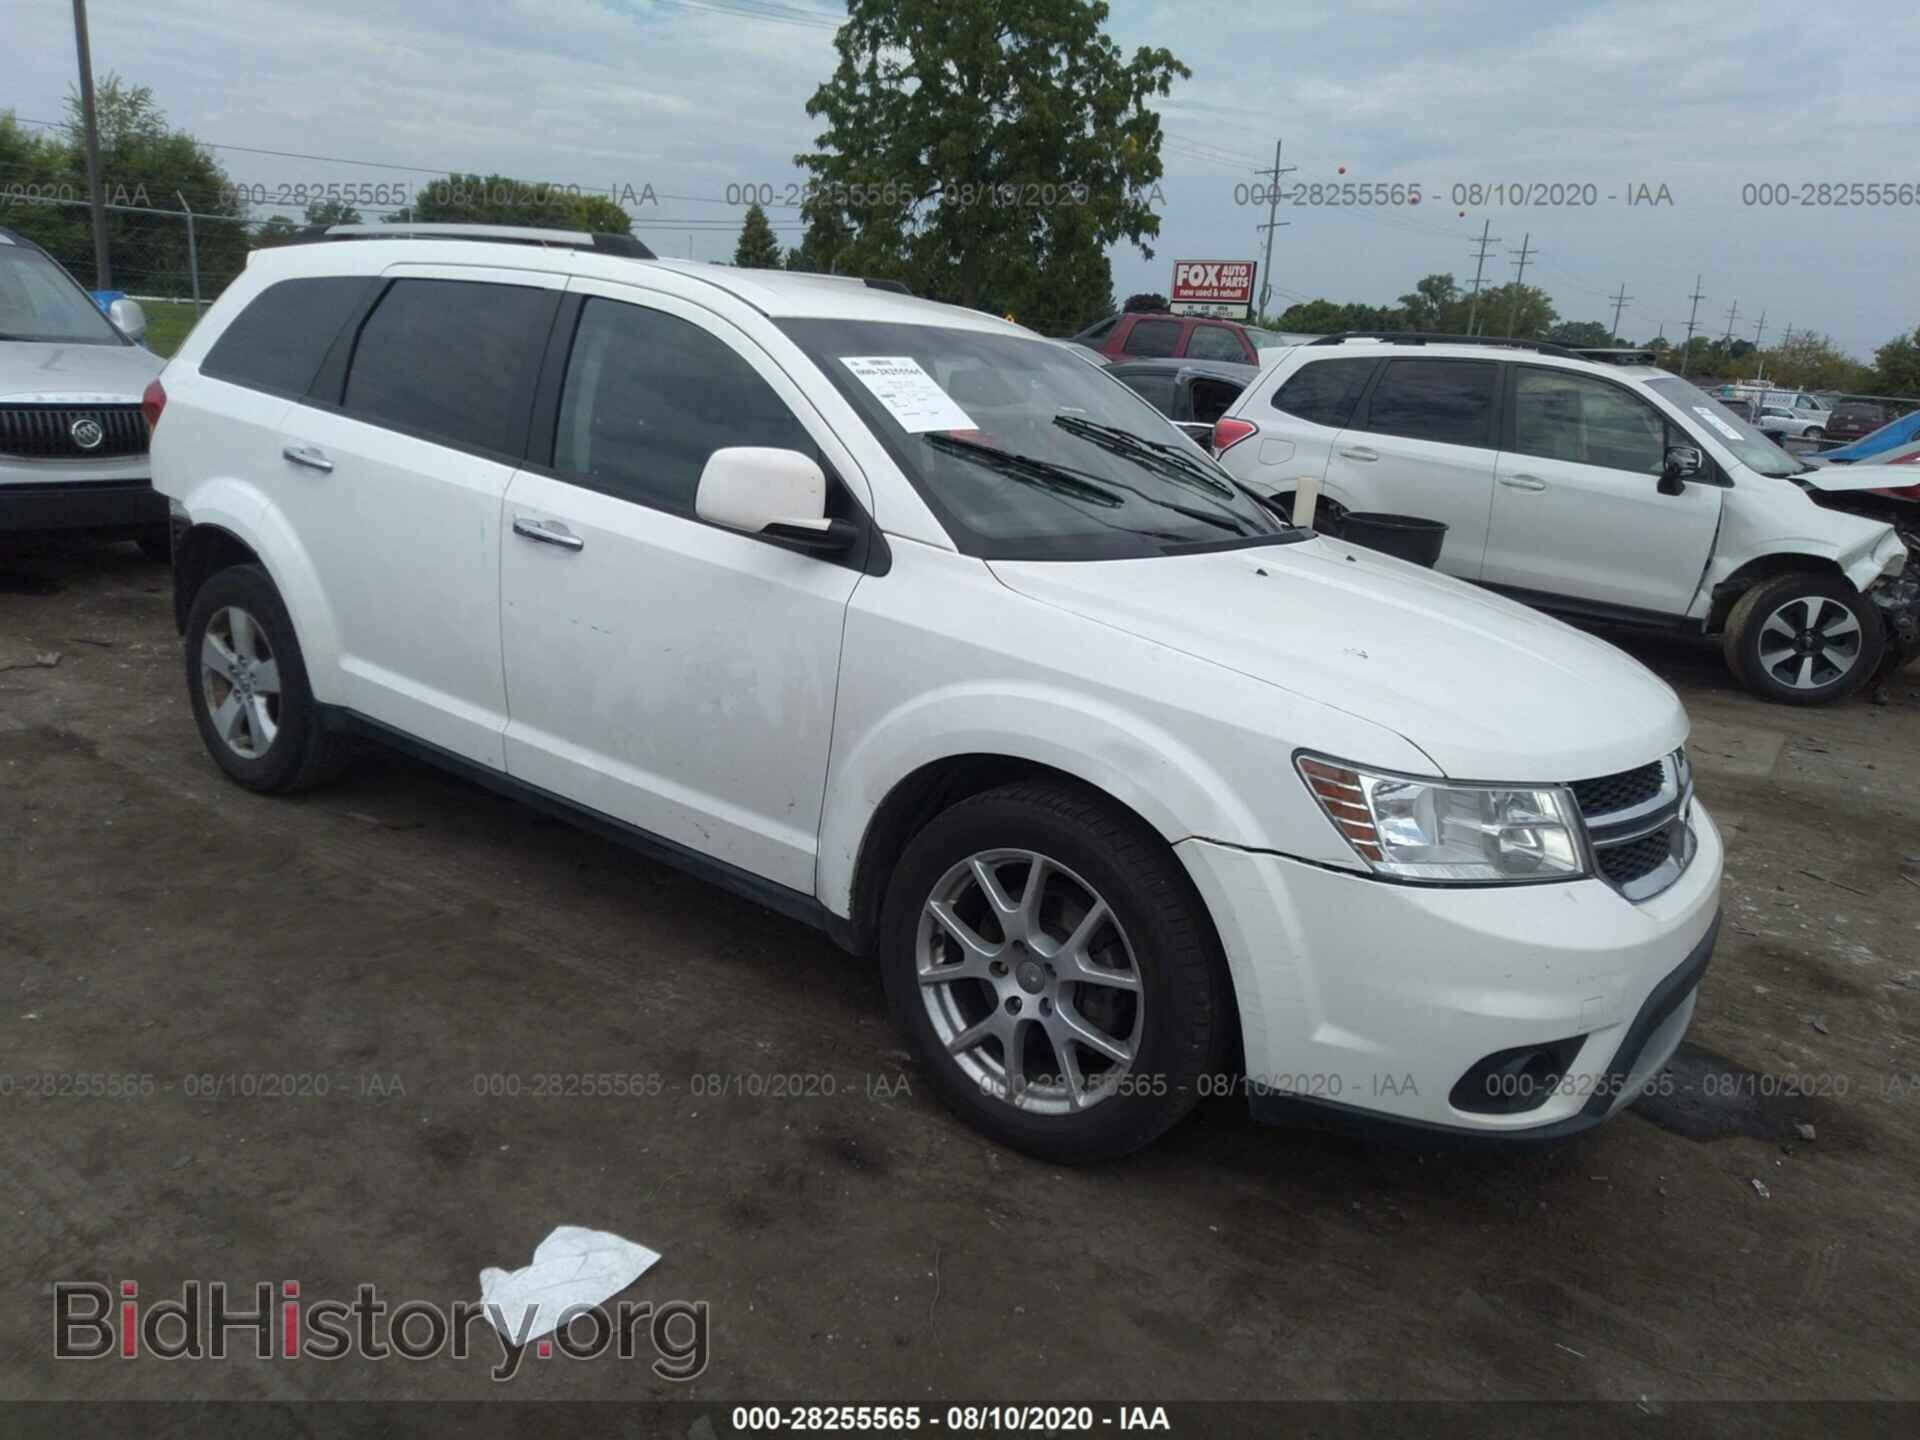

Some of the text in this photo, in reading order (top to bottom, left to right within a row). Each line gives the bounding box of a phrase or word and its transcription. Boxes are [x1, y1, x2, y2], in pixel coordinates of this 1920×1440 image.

[1177, 265, 1220, 287] FOX
[1222, 265, 1247, 276] AUTO
[1220, 277, 1249, 288] PARTS
